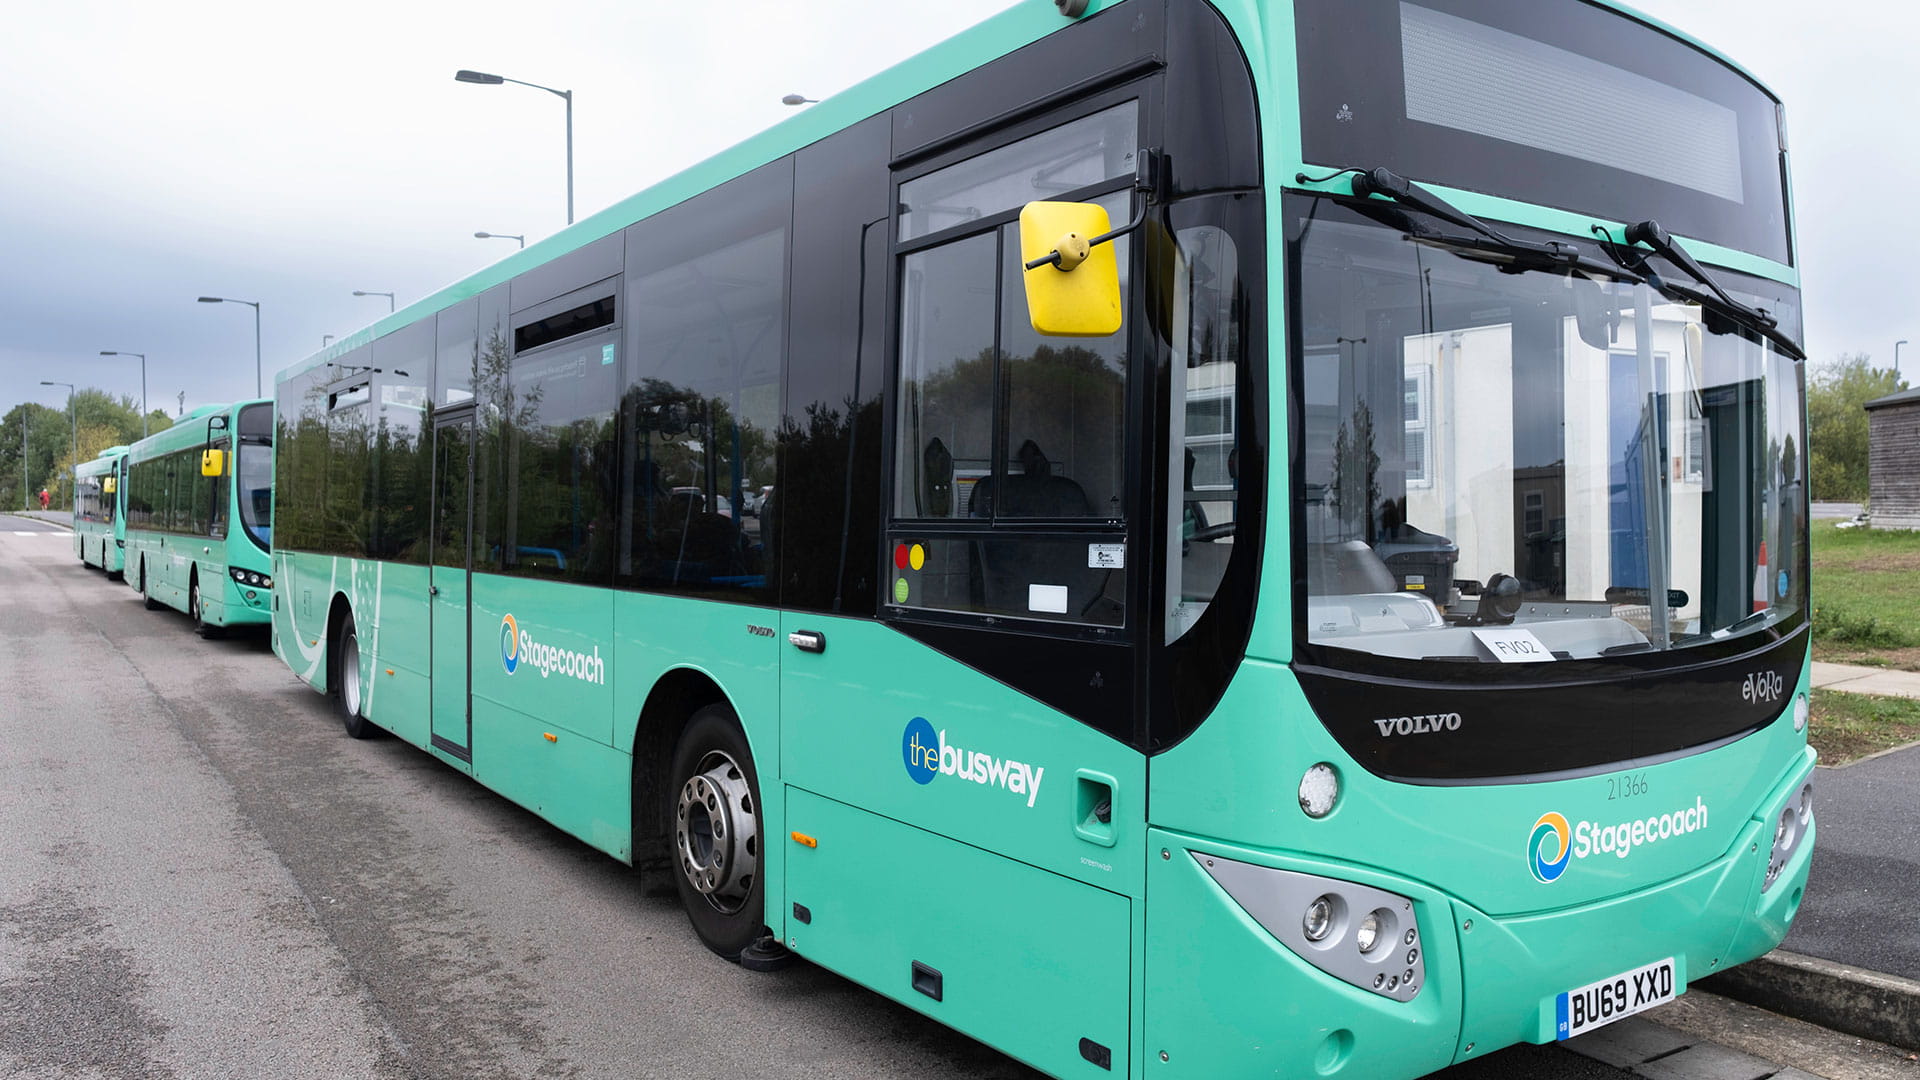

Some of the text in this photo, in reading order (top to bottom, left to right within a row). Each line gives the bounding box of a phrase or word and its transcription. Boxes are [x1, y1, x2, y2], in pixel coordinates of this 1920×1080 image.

[519, 629, 605, 685] Stagecoach
[1495, 640, 1540, 655] FV02
[1374, 712, 1462, 737] VOLVO
[1607, 773, 1648, 800] 21366
[1574, 795, 1708, 859] Stagecoach
[1572, 964, 1672, 1030] BU69 XXD
